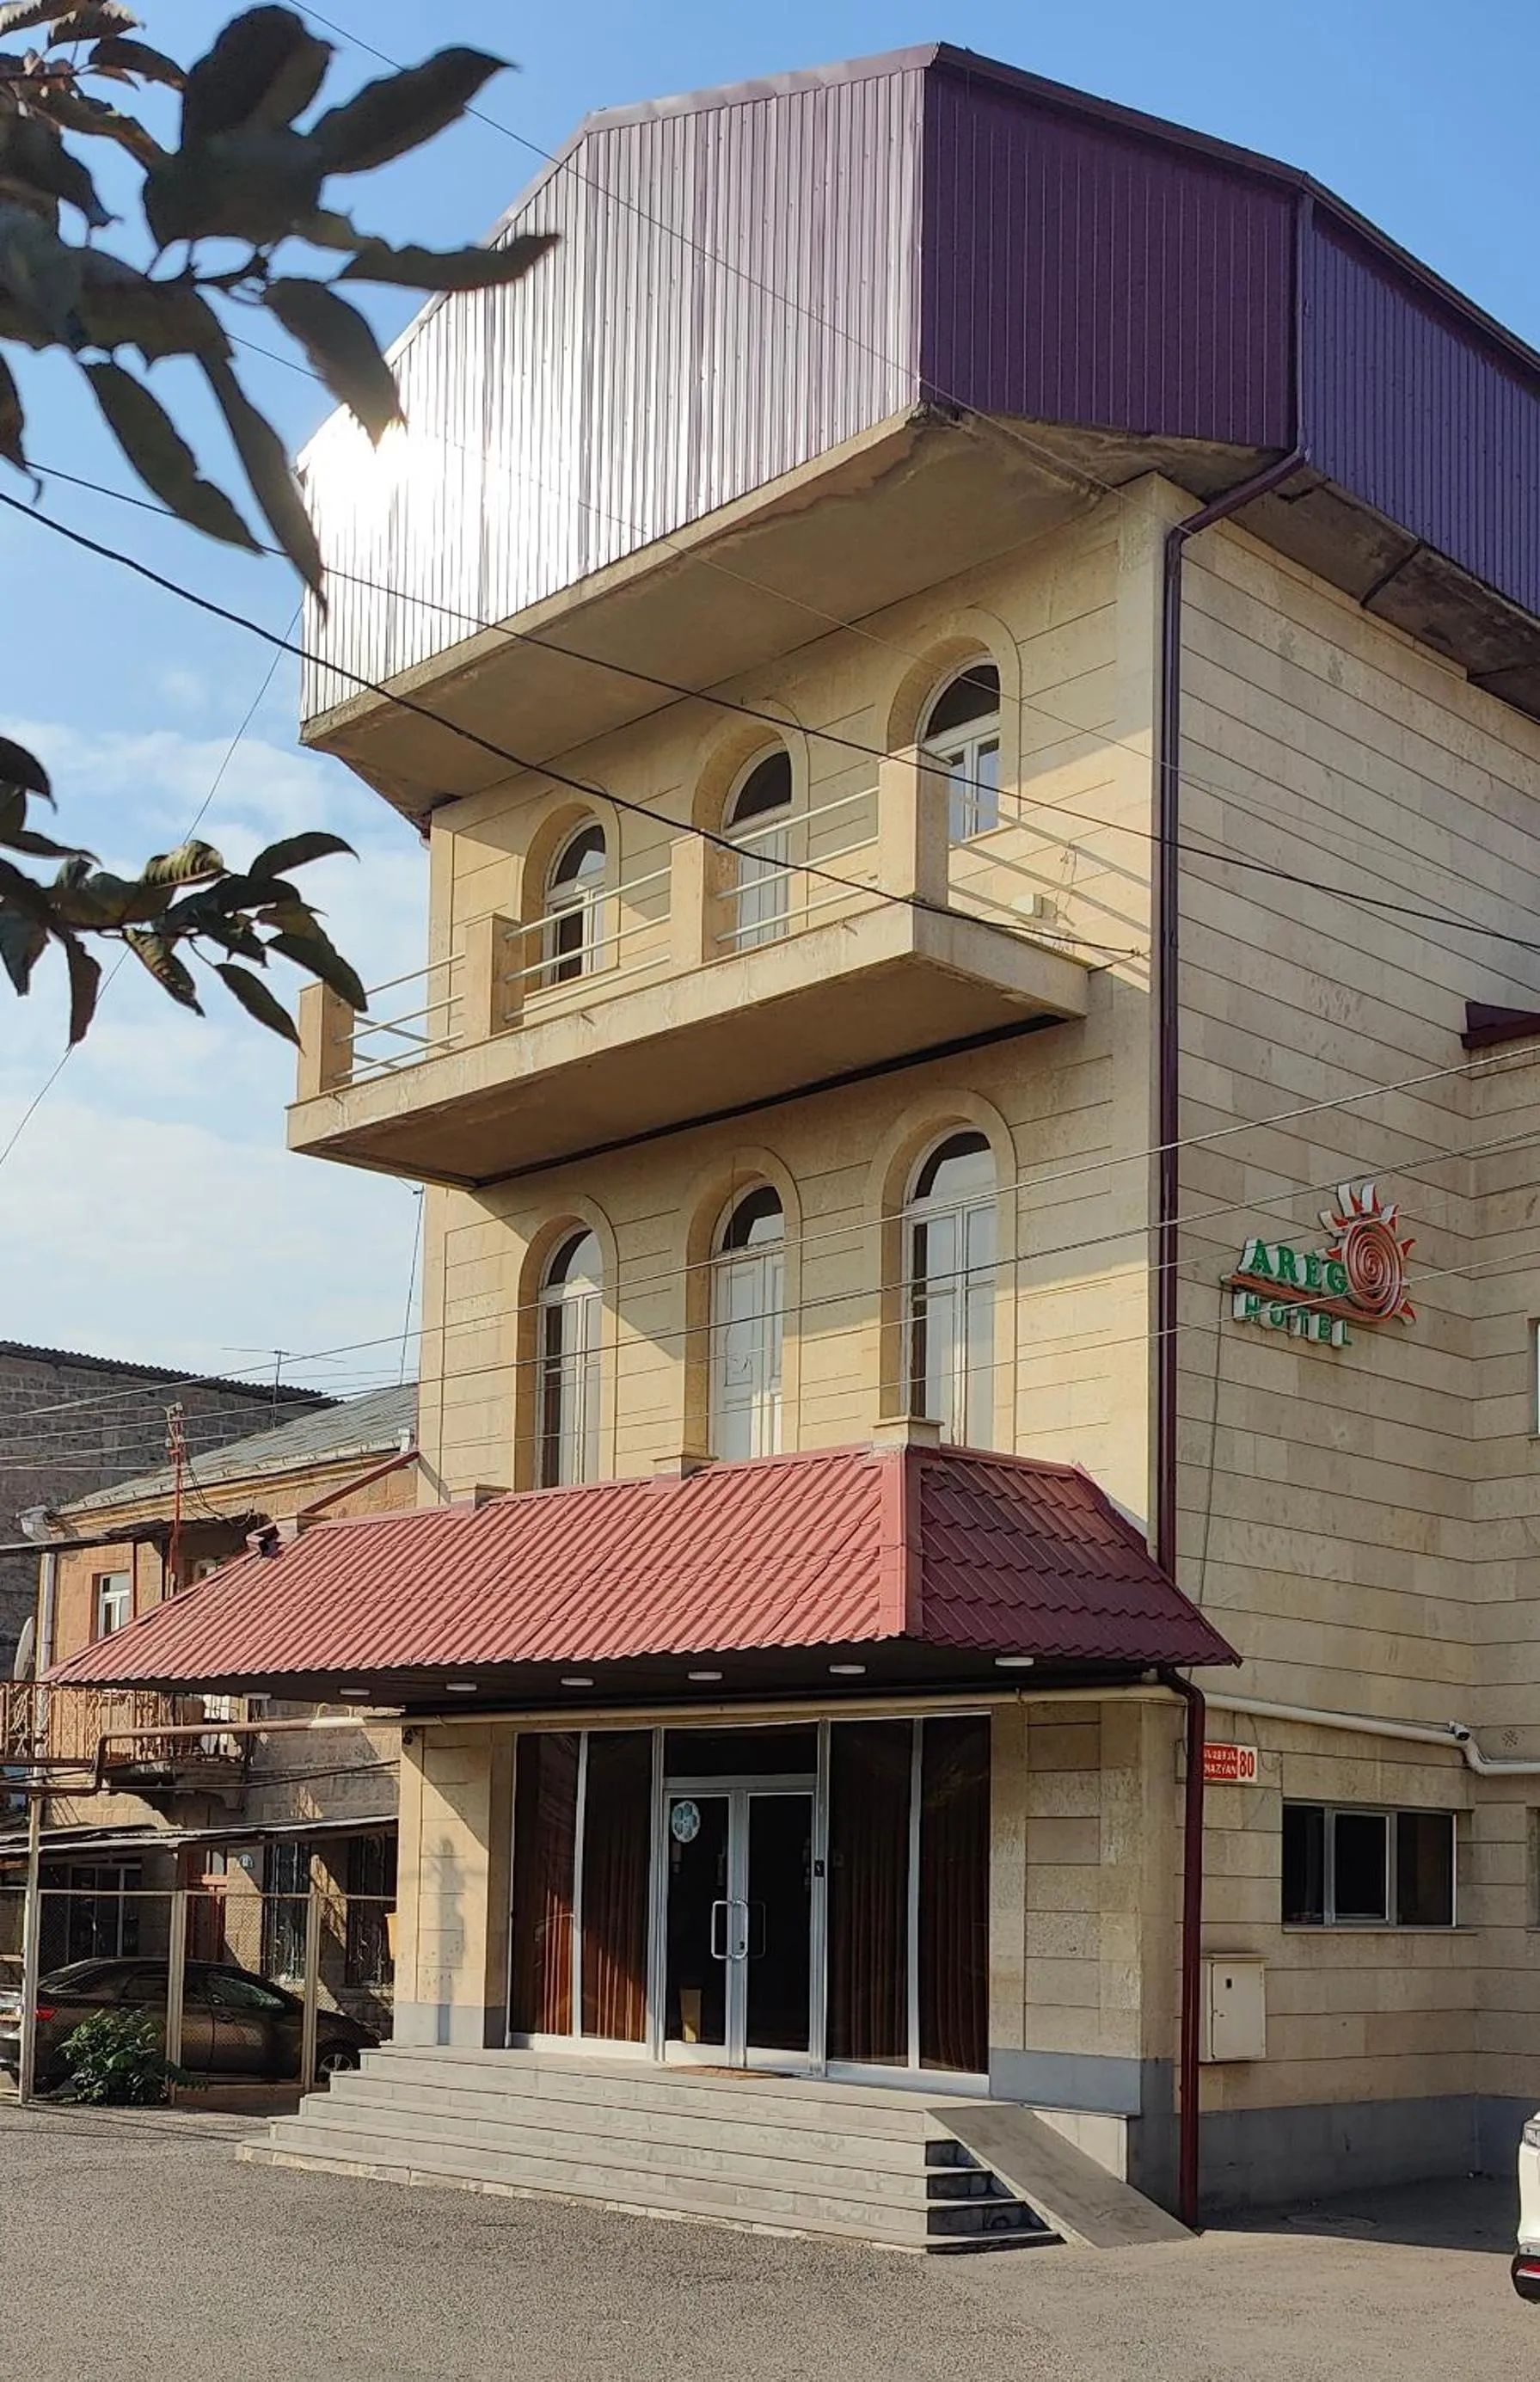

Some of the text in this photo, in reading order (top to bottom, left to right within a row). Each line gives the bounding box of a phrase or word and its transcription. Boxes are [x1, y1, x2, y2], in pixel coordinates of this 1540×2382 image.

[1242, 1237, 1348, 1295] AREG
[1238, 1292, 1353, 1347] HOTEL
[1239, 1750, 1255, 1777] 80
